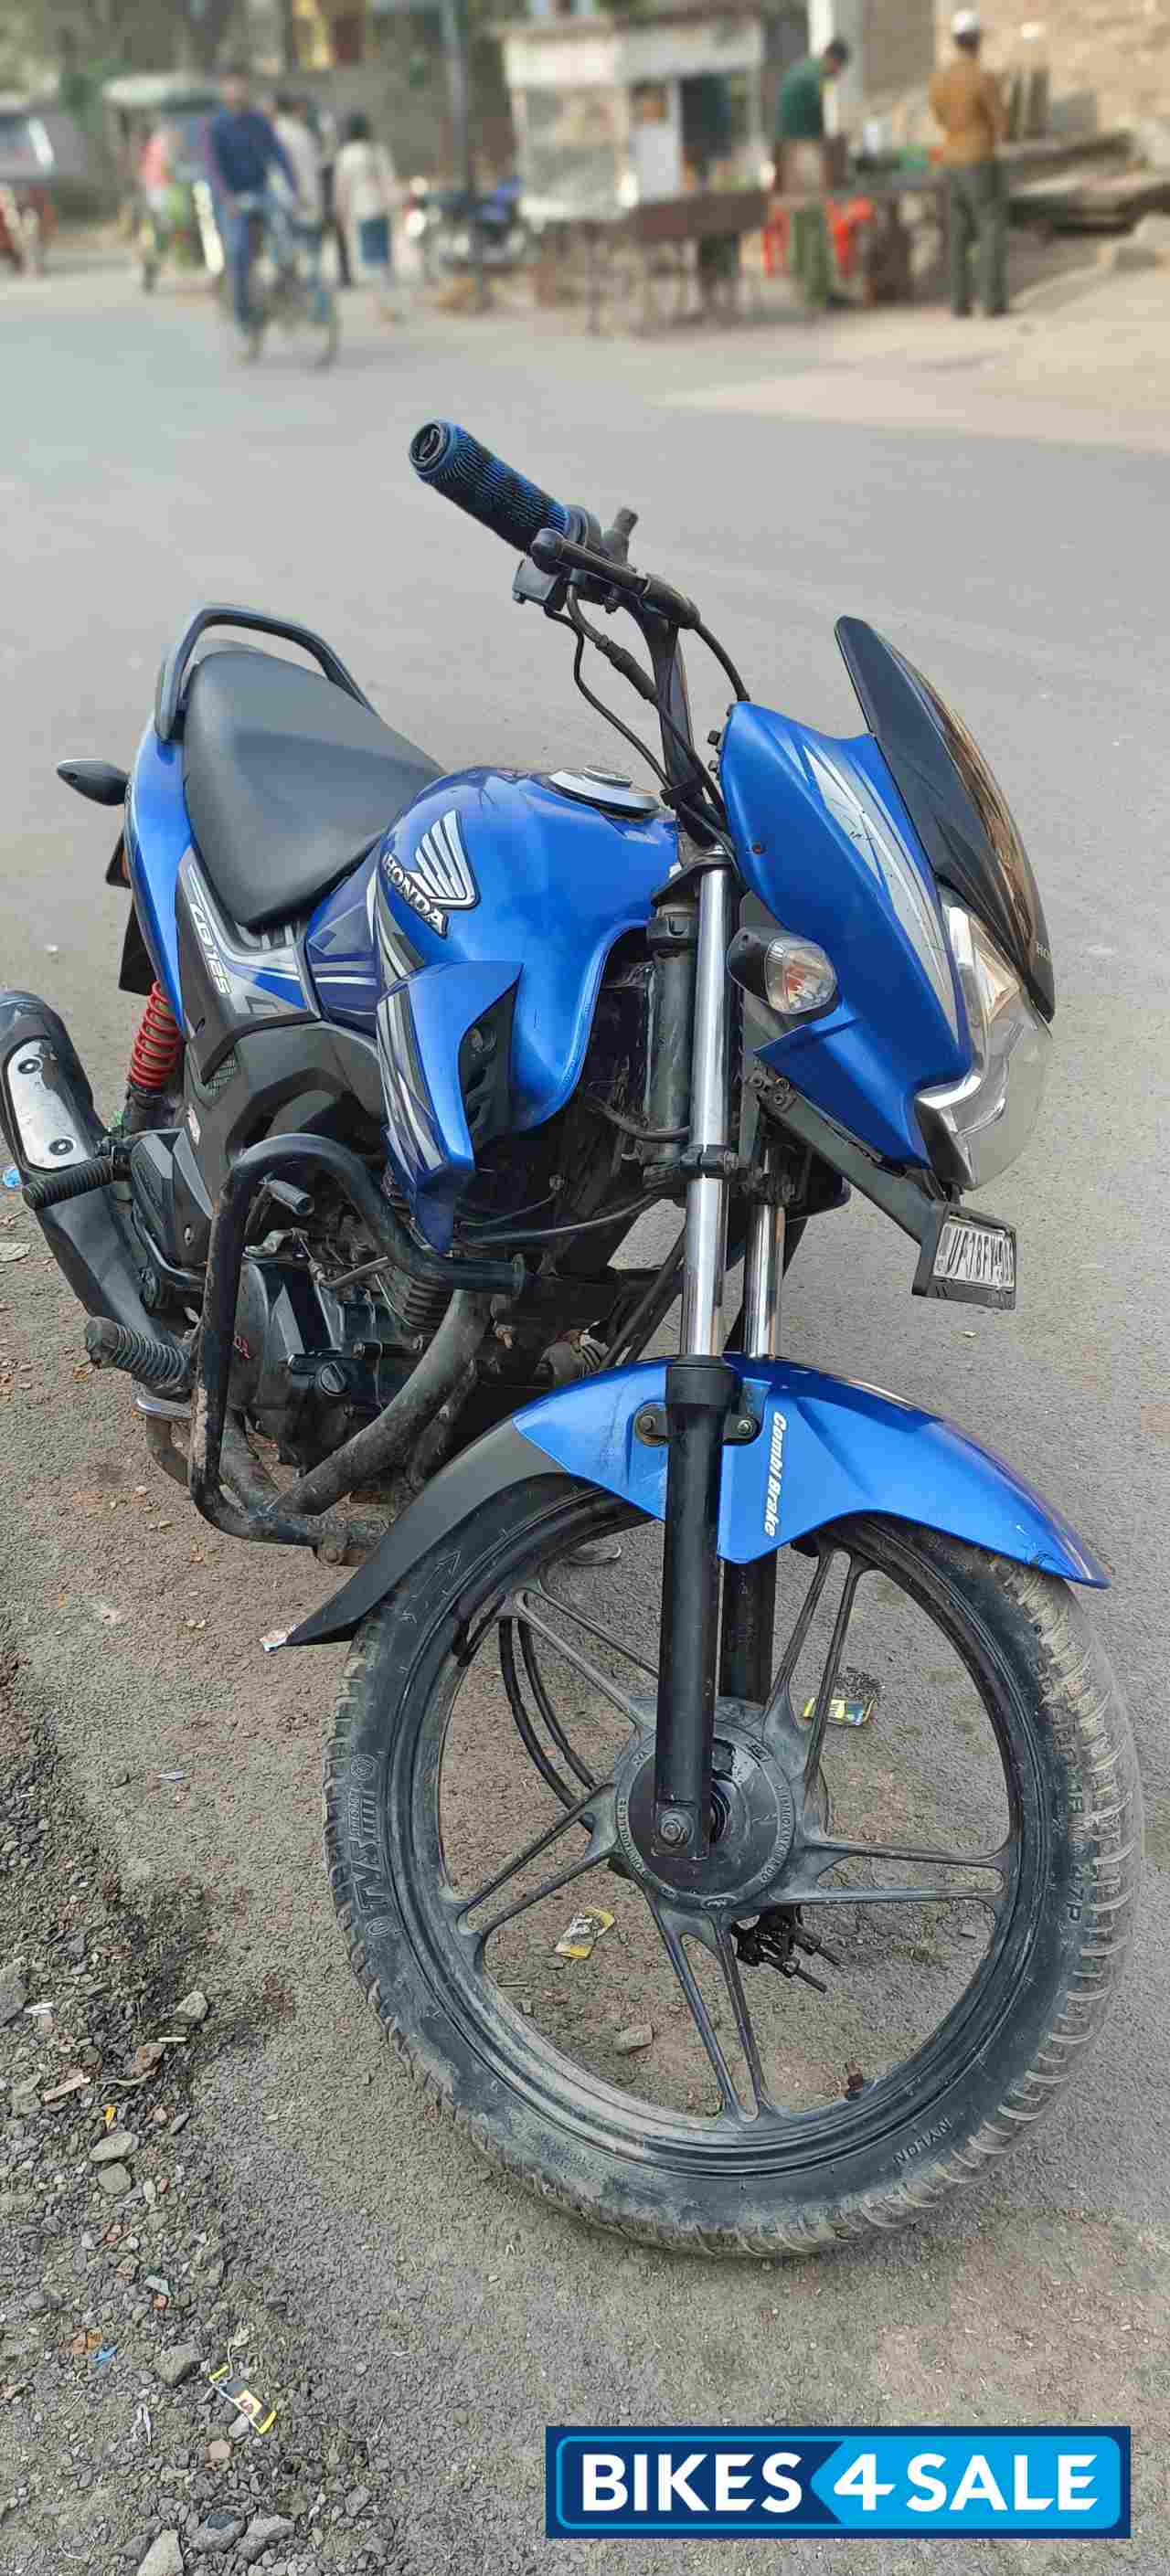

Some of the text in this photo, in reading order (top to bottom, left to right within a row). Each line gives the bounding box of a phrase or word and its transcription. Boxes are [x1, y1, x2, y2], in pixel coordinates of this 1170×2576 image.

[380, 851, 445, 937] HONDA
[763, 1410, 787, 1537] Combi Brake
